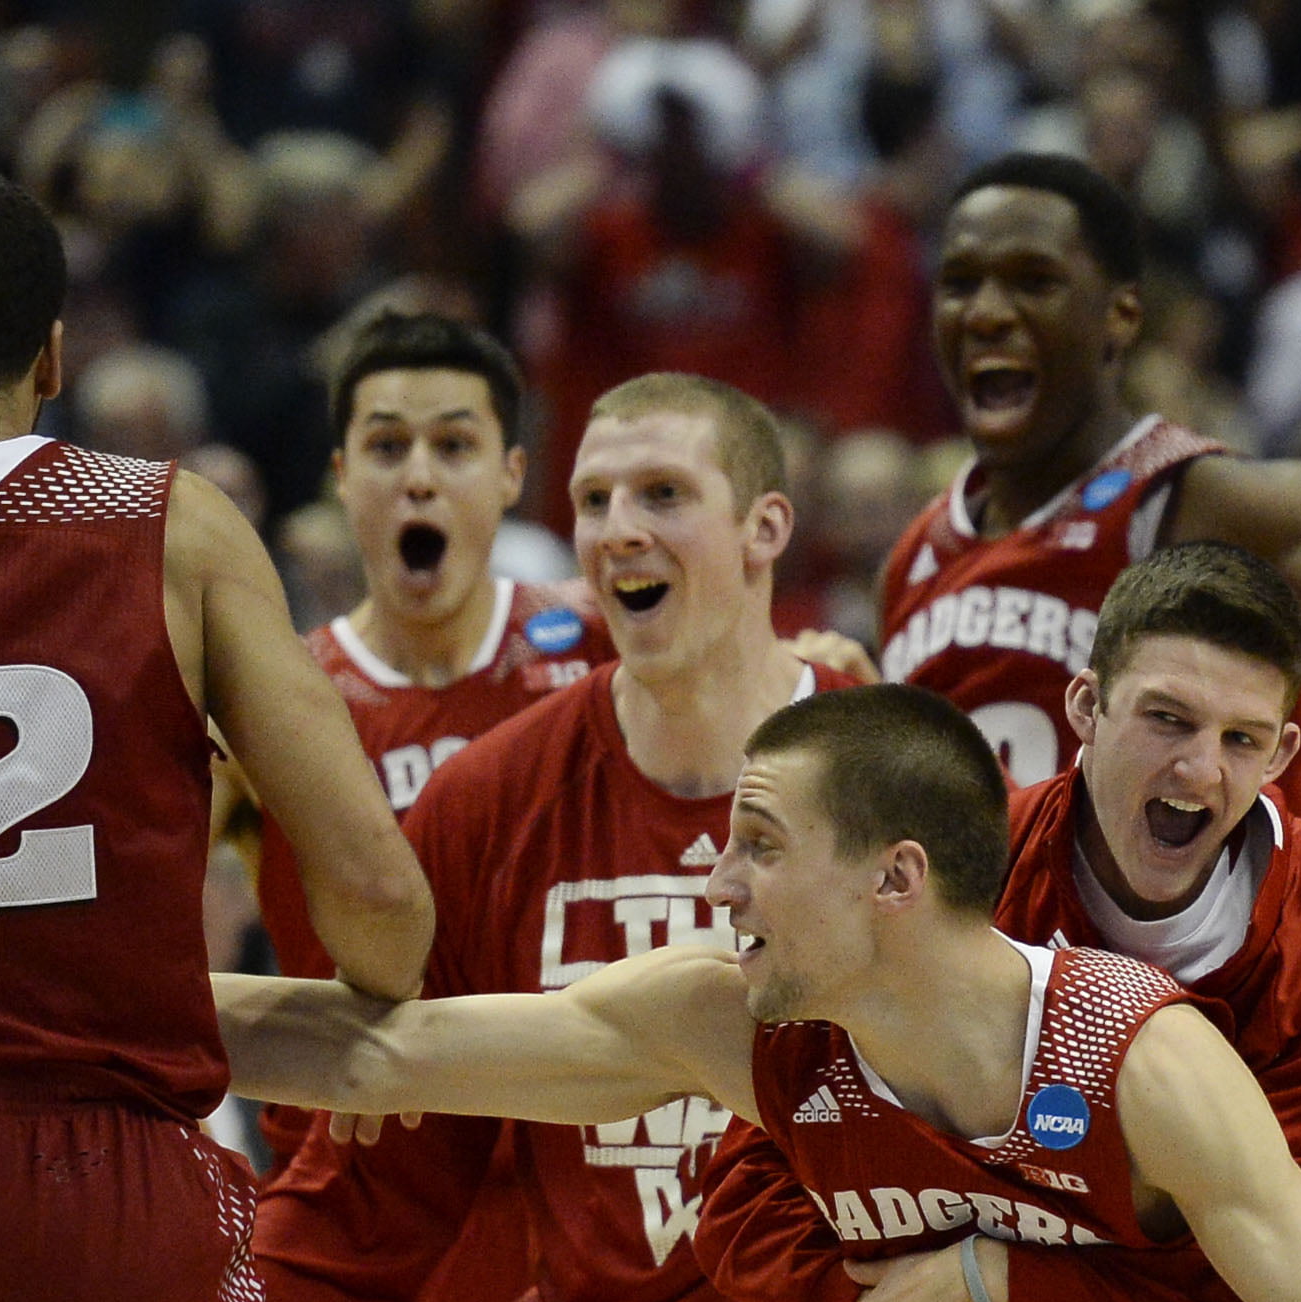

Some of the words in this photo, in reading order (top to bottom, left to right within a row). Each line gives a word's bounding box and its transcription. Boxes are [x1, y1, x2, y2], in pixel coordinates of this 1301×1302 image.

[793, 1108, 842, 1123] adida
[1034, 1114, 1085, 1135] NCAA
[804, 1187, 1114, 1245] ADGER
